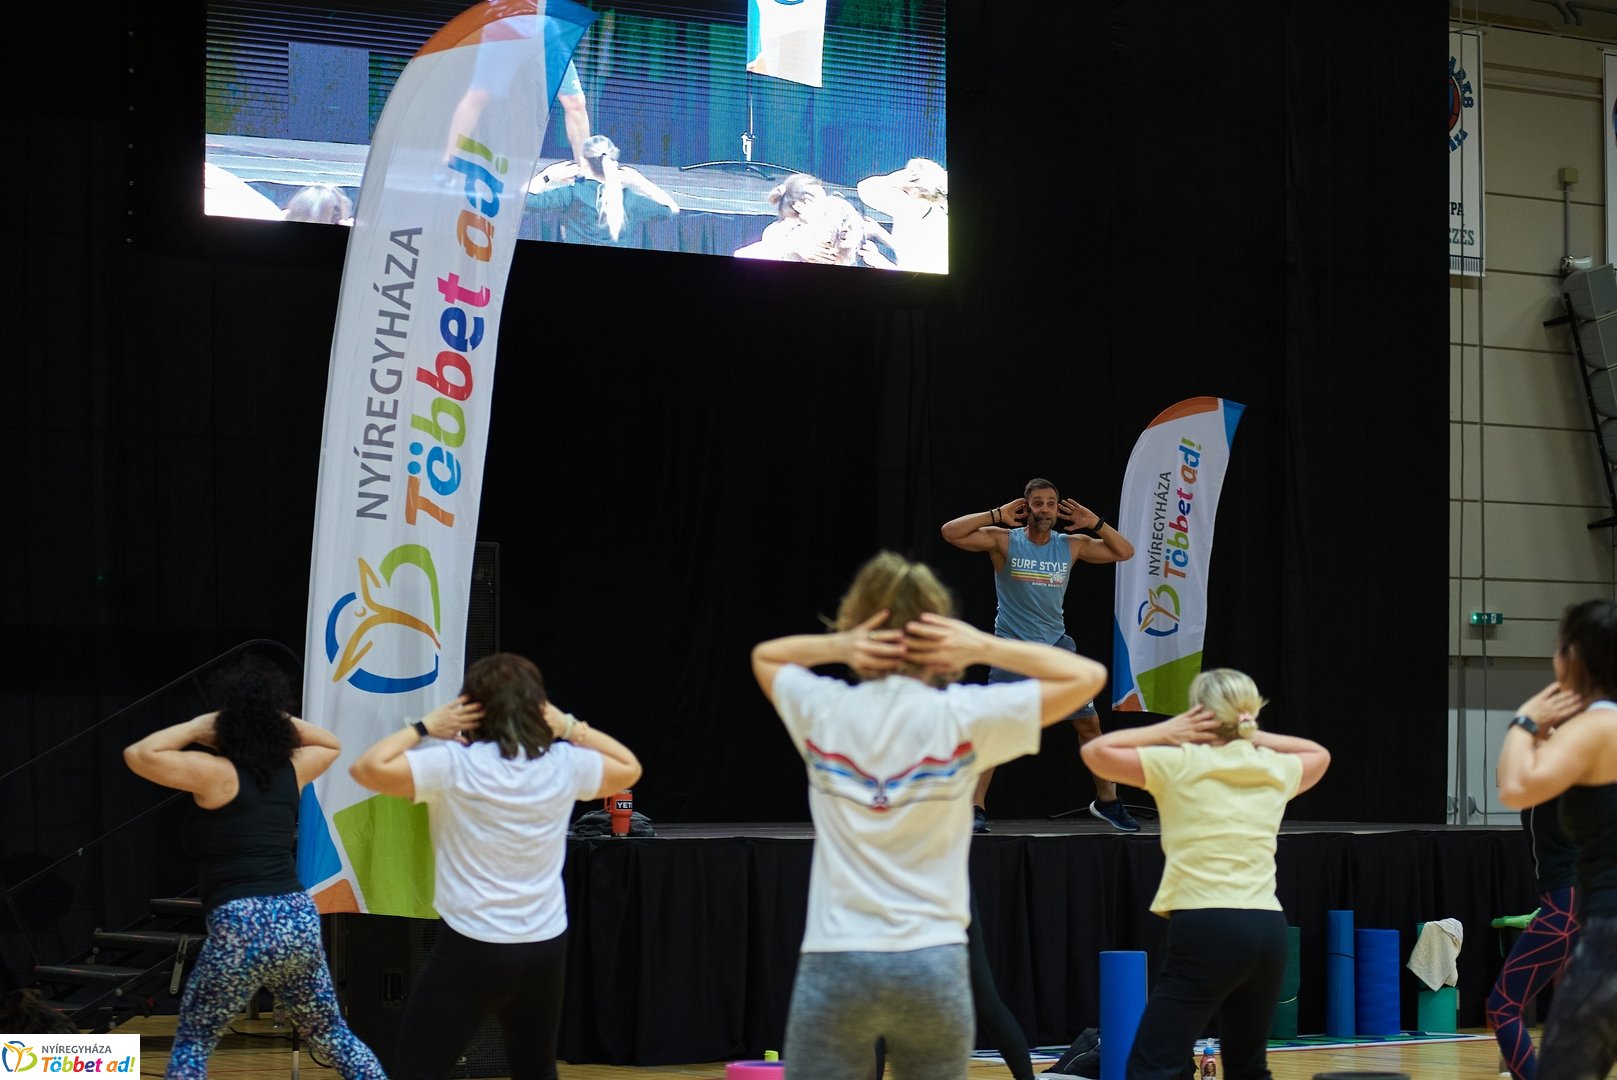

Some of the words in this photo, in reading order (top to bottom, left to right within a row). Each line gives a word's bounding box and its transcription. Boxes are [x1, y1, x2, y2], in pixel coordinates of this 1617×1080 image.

[353, 226, 423, 520] NYÍREGYHÁZA
[405, 272, 491, 528] Többet
[448, 134, 509, 262] ad!
[1011, 557, 1037, 570] SURF
[1040, 561, 1068, 572] STYLE
[1148, 471, 1172, 576] NYÍREGYHÁZA
[1164, 487, 1193, 579] Többet
[1179, 437, 1202, 485] ad!
